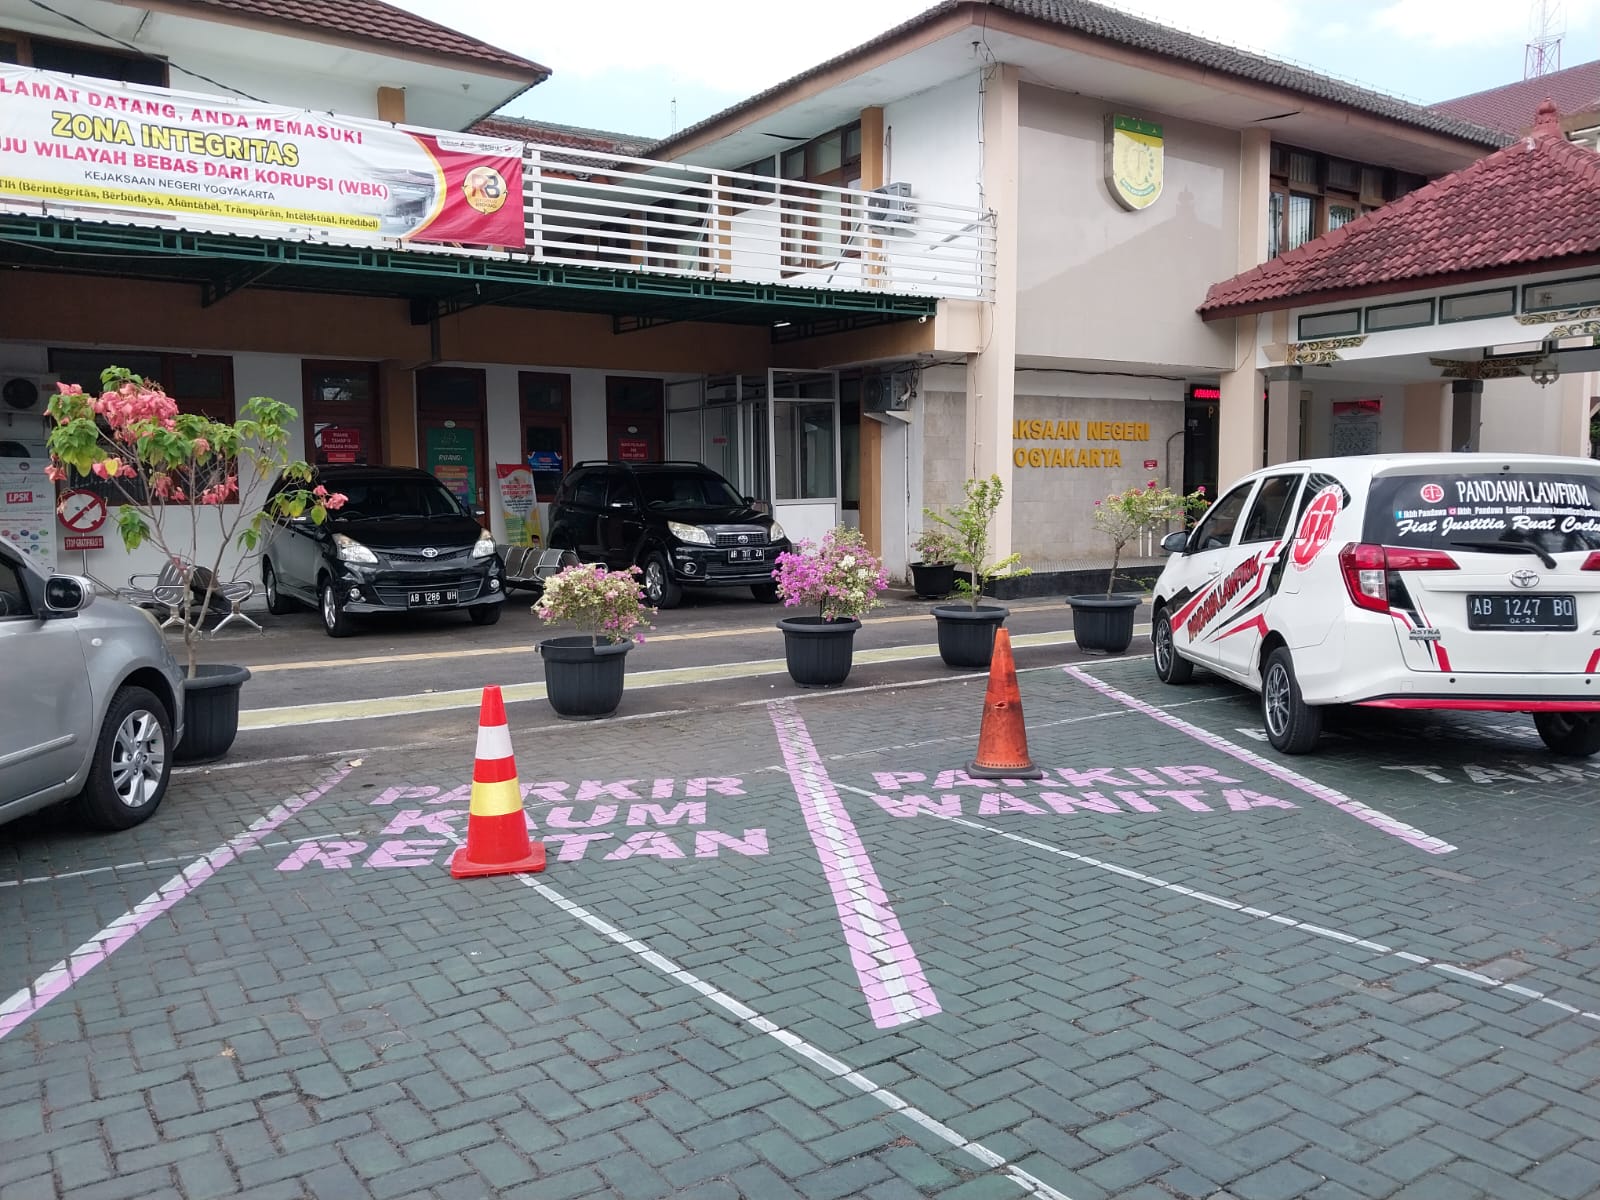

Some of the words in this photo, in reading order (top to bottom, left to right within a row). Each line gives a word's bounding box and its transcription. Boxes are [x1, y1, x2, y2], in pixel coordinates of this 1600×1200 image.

[0, 78, 80, 104] LAMAT
[88, 91, 183, 122] DATANG,
[191, 107, 249, 129] ANDA
[256, 117, 363, 144] MEMASUKI
[51, 110, 135, 146] ZONA
[141, 123, 299, 167] INTEGRITAS
[0, 135, 28, 154] JU
[34, 141, 127, 166] WILAYAH
[133, 154, 198, 174] BEBAS
[204, 161, 249, 181] DARI
[254, 168, 334, 192] KORUPSI
[338, 179, 389, 200] (WBK)
[84, 170, 156, 187] KEJAKSAAN
[158, 178, 201, 192] NEGERI
[203, 183, 276, 201] YOGYAKARTA
[1087, 421, 1150, 441] NEGERI
[1014, 447, 1122, 468] OGYAKARTA
[8, 493, 30, 503] LPSK
[1456, 479, 1530, 503] PANDAWA
[1528, 481, 1591, 506] LAWFIRM
[1396, 519, 1437, 536] Fiat
[1441, 516, 1507, 536] Justitia
[1512, 515, 1556, 530] Ruat
[411, 593, 419, 603] AB
[447, 591, 457, 600] UH
[1473, 599, 1492, 616] AB
[1504, 599, 1541, 616] 1247
[869, 789, 1303, 818] WANITA
[275, 828, 770, 871] RETAN
